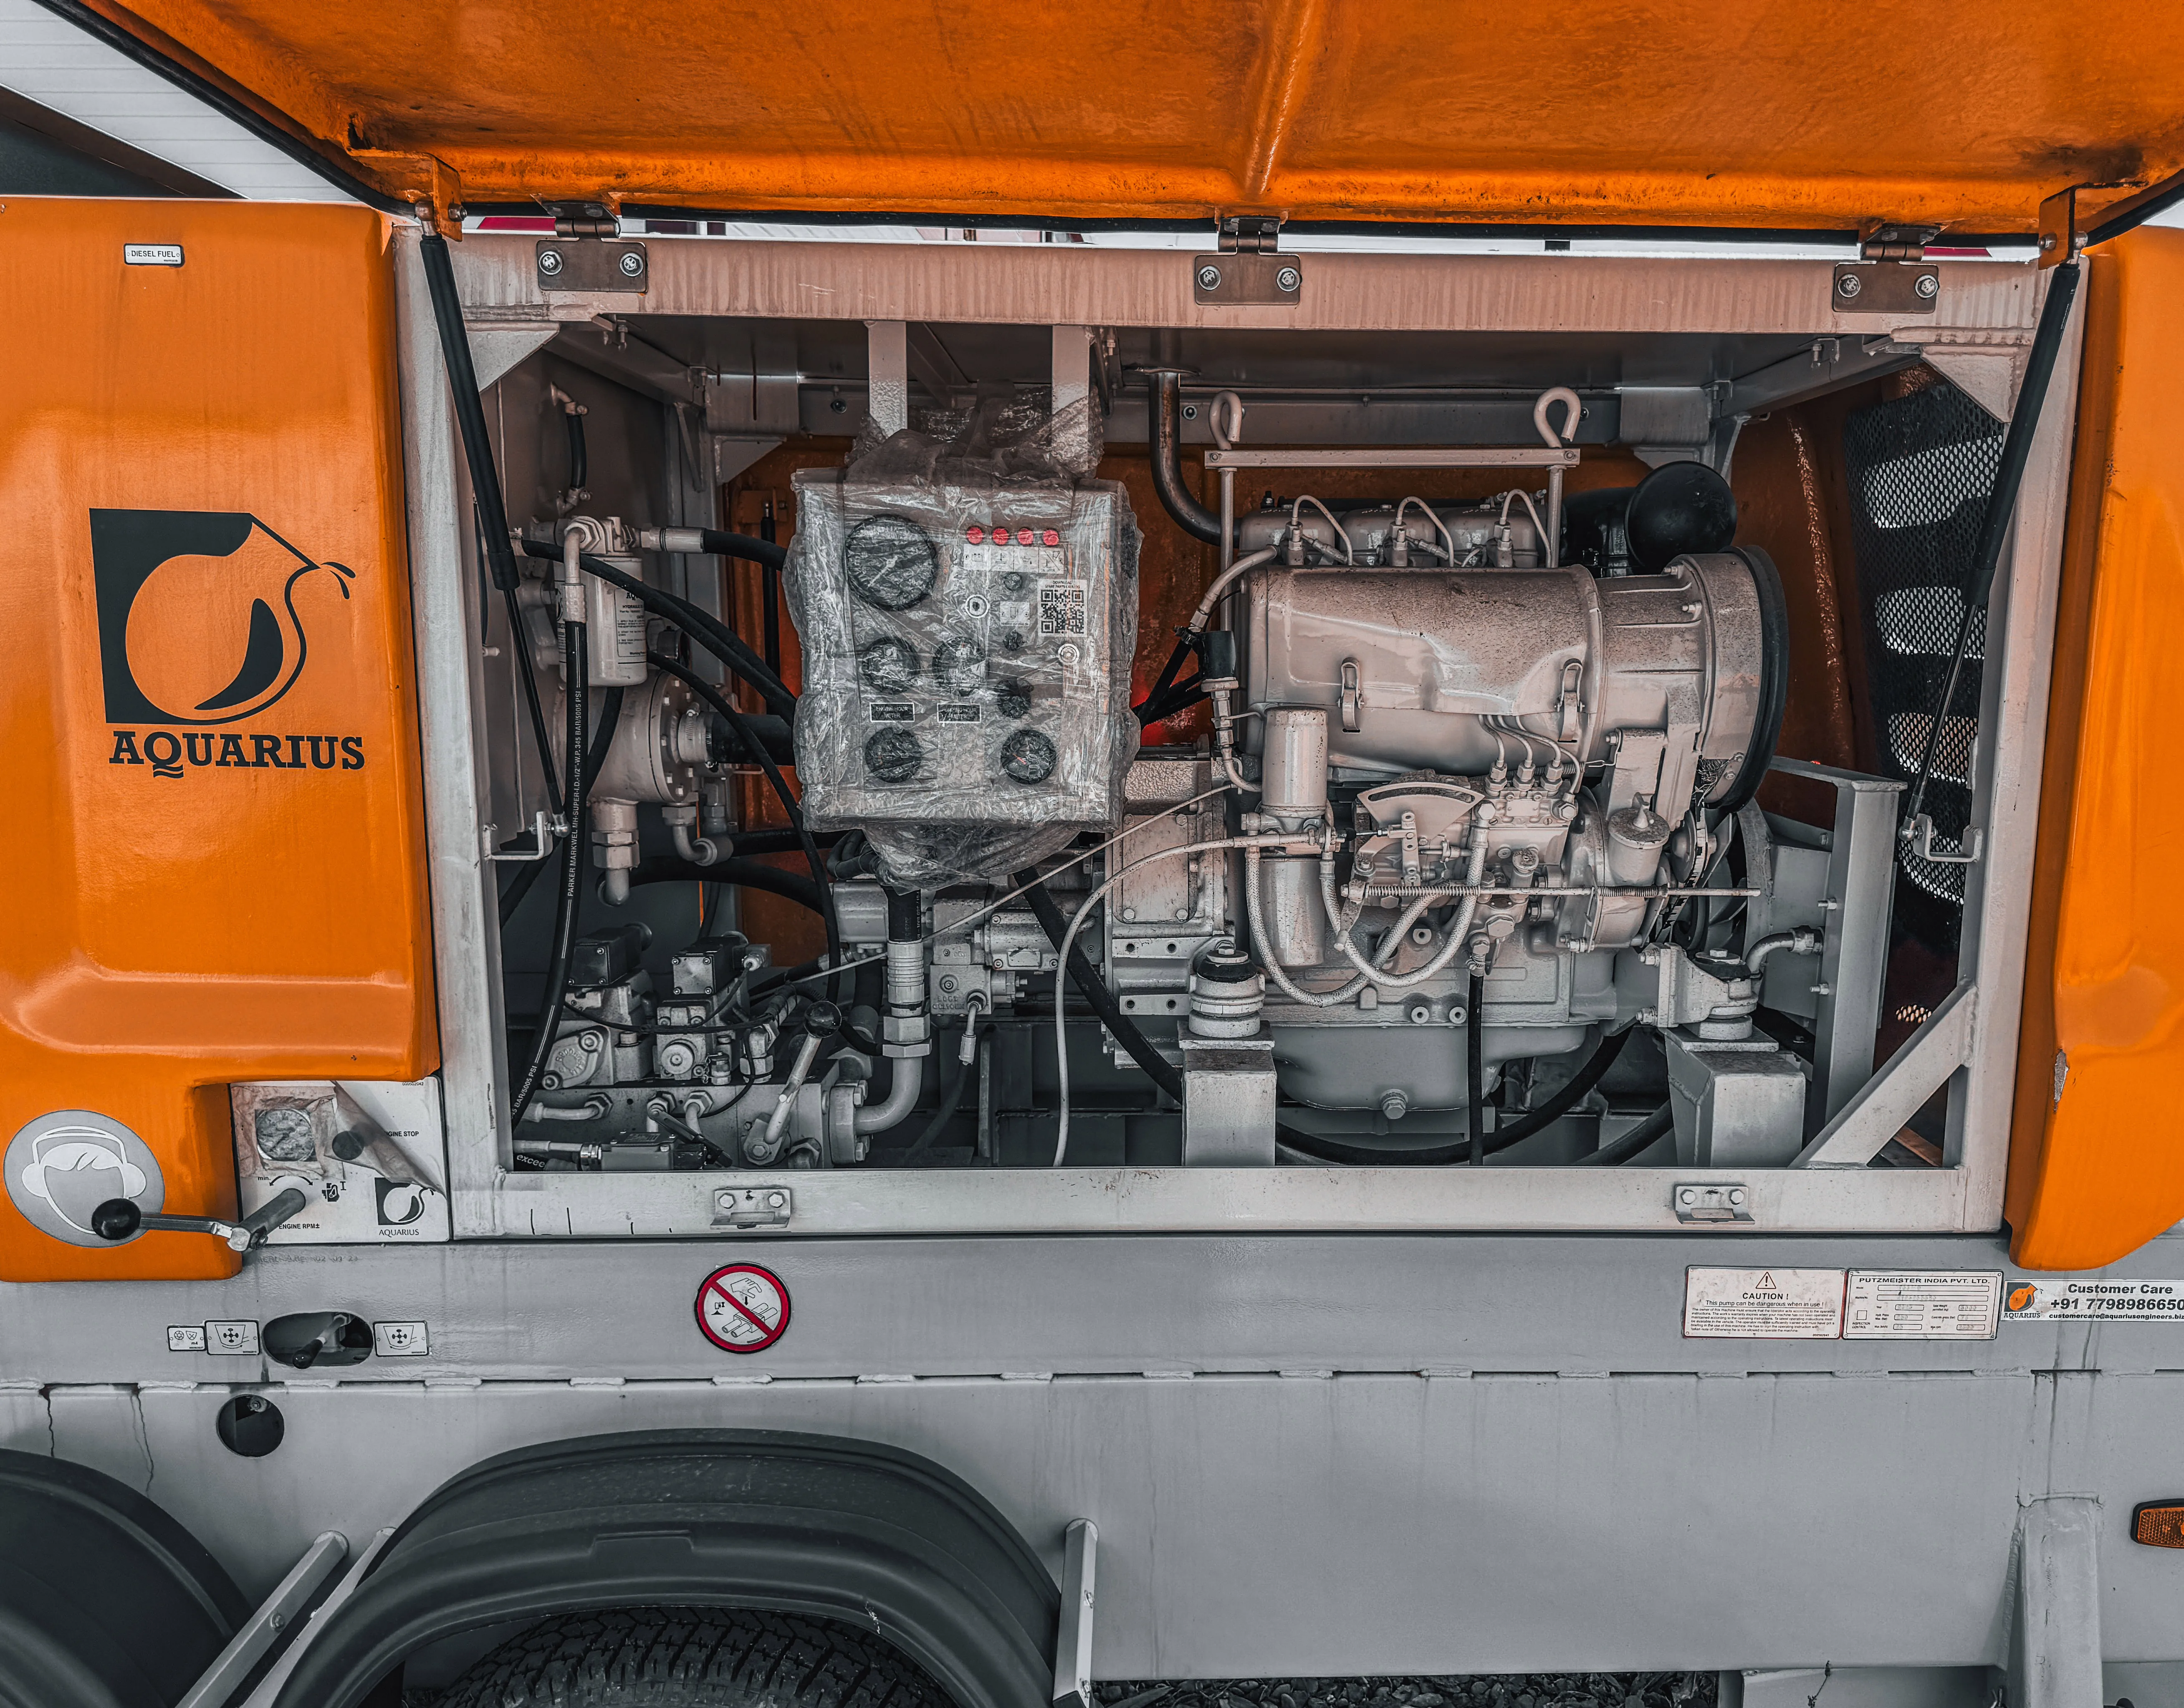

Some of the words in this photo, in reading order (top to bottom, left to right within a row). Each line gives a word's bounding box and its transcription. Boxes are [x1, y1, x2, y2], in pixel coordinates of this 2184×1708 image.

[109, 731, 365, 778] AQUARIUS
[570, 830, 578, 866] MARKWEL
[514, 1078, 532, 1108] BAR/5005
[528, 1065, 538, 1077] PSI
[379, 1229, 419, 1238] AQUARIUS
[2068, 1284, 2136, 1294] Customer
[2140, 1284, 2173, 1294] Care
[2051, 1298, 2078, 1309] +91
[2086, 1298, 2184, 1310] 7798986650
